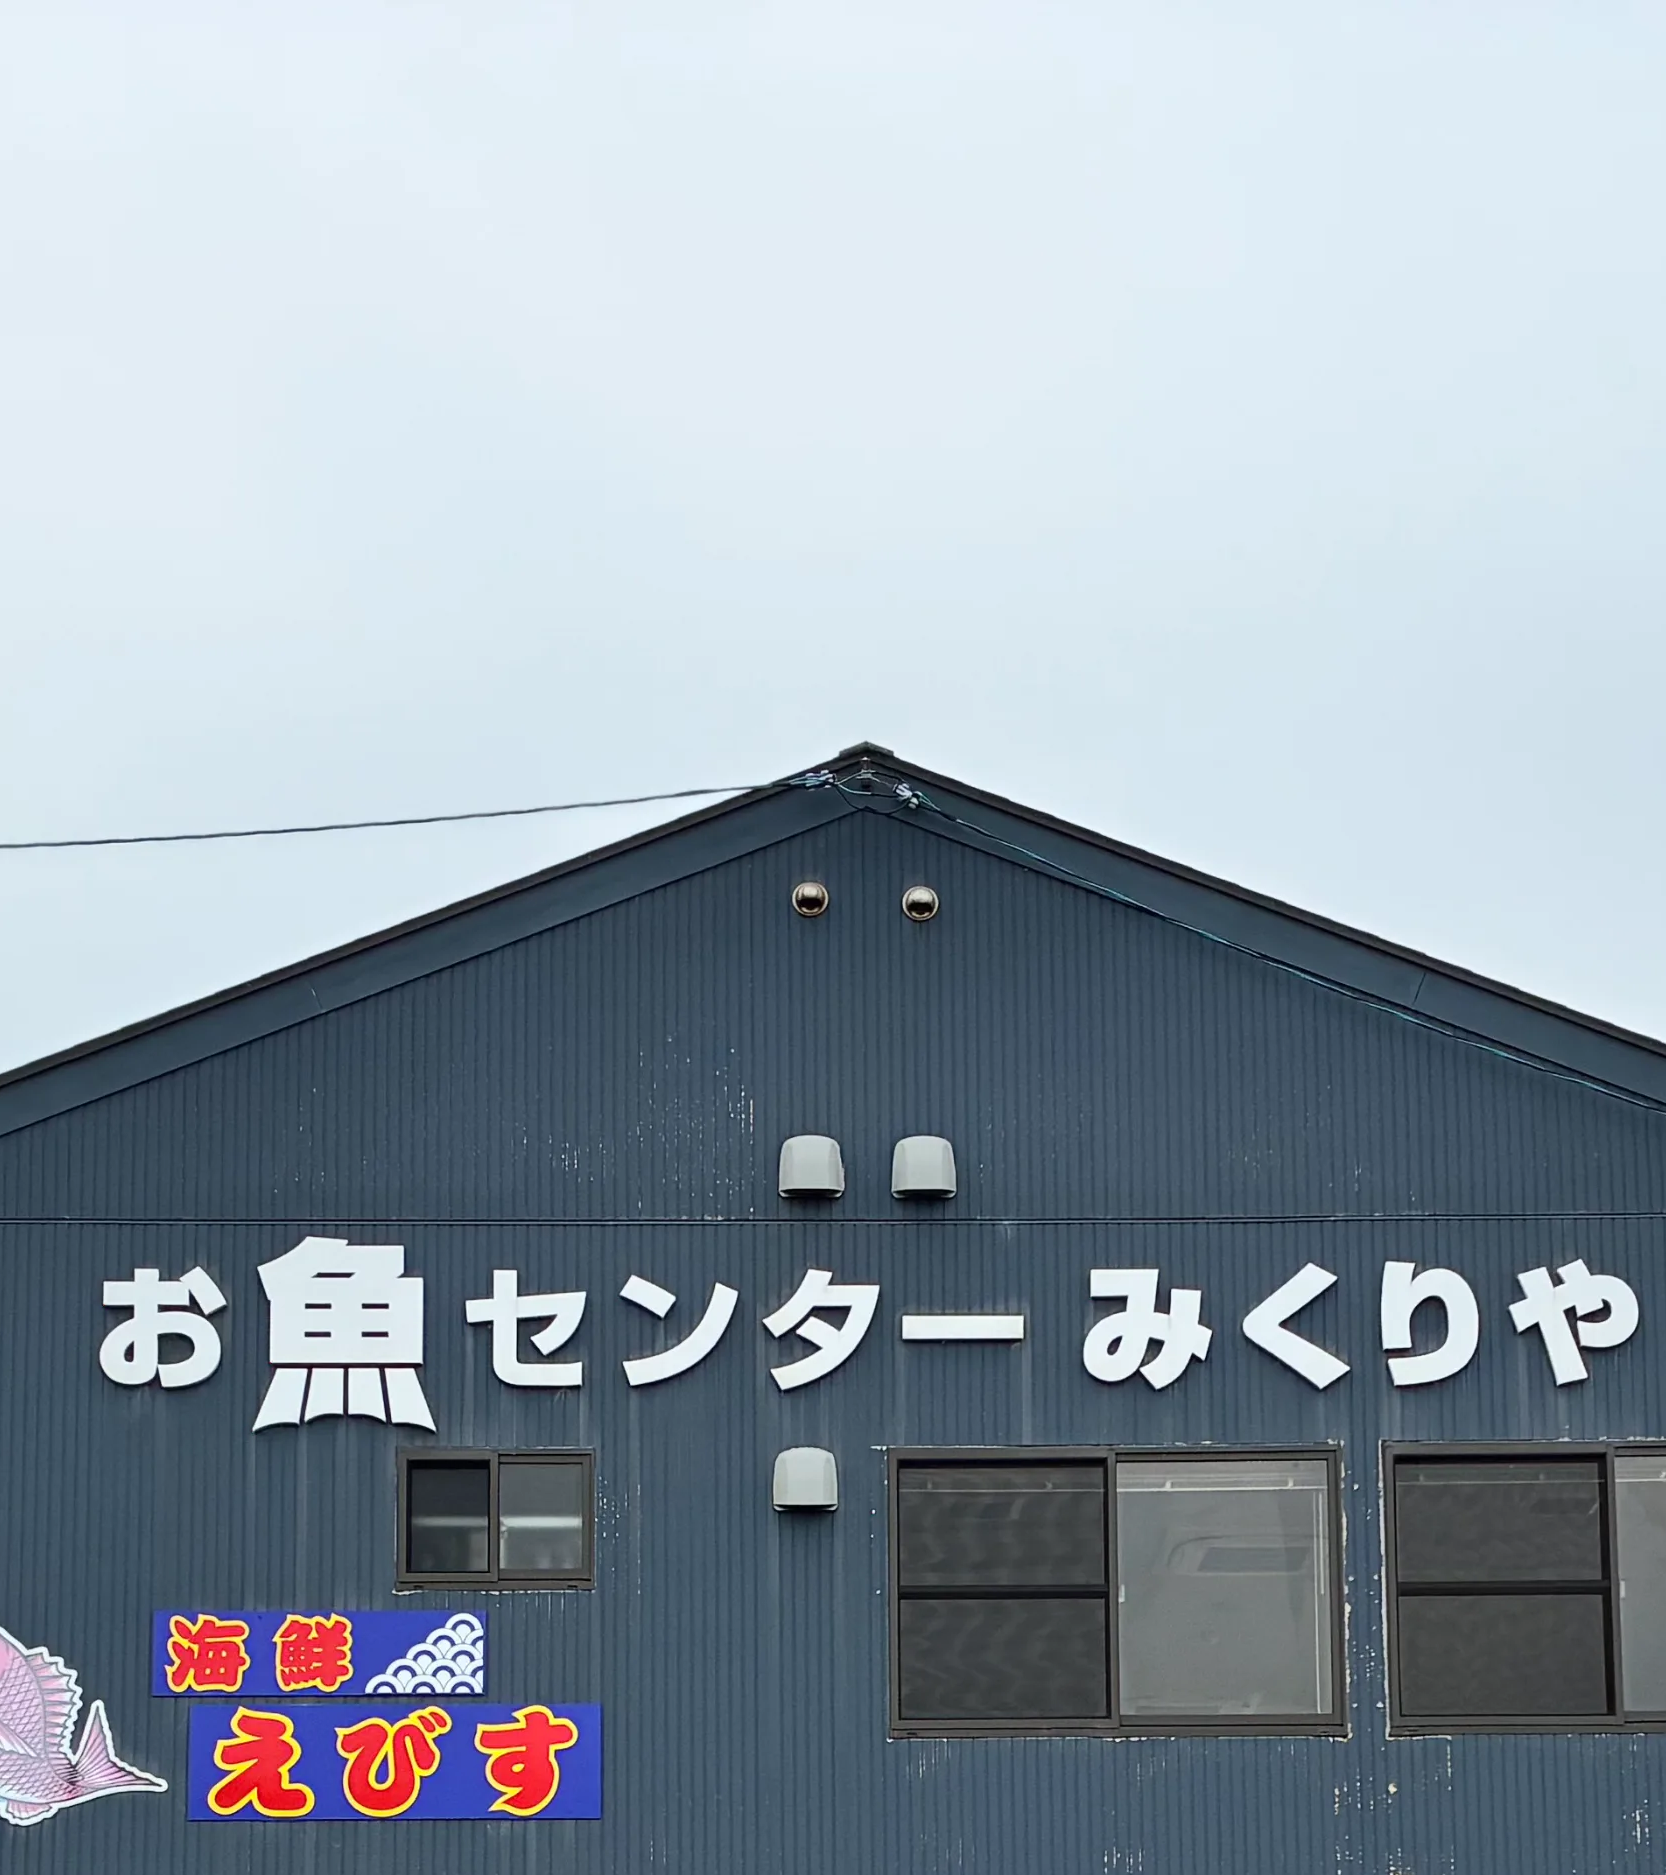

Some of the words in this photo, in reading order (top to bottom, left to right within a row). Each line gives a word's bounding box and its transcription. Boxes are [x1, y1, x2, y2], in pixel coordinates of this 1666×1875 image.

[98, 1236, 1641, 1432] お魚センターみくりや
[166, 1614, 353, 1693] 海鮮
[206, 1705, 579, 1818] えびす
